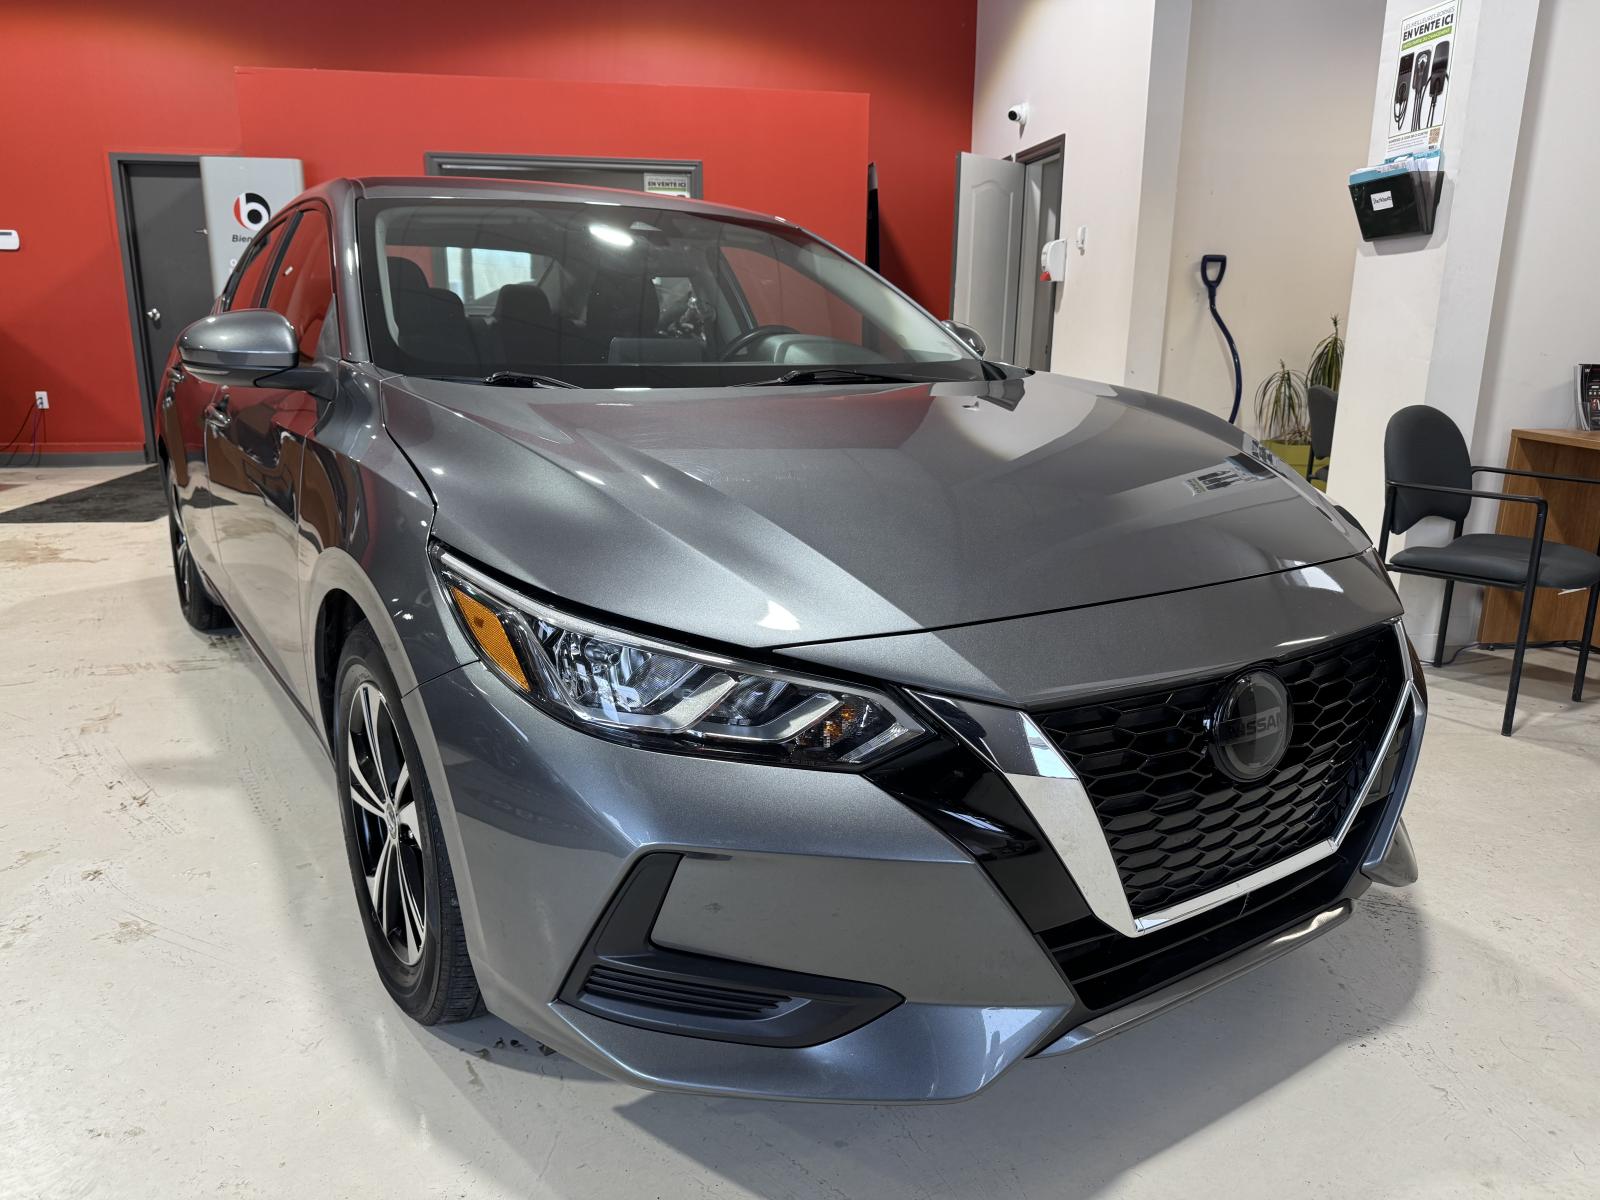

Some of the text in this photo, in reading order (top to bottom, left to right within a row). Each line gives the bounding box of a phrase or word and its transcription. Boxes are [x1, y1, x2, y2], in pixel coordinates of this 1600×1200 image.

[1403, 14, 1454, 41] EN VENTE ICI
